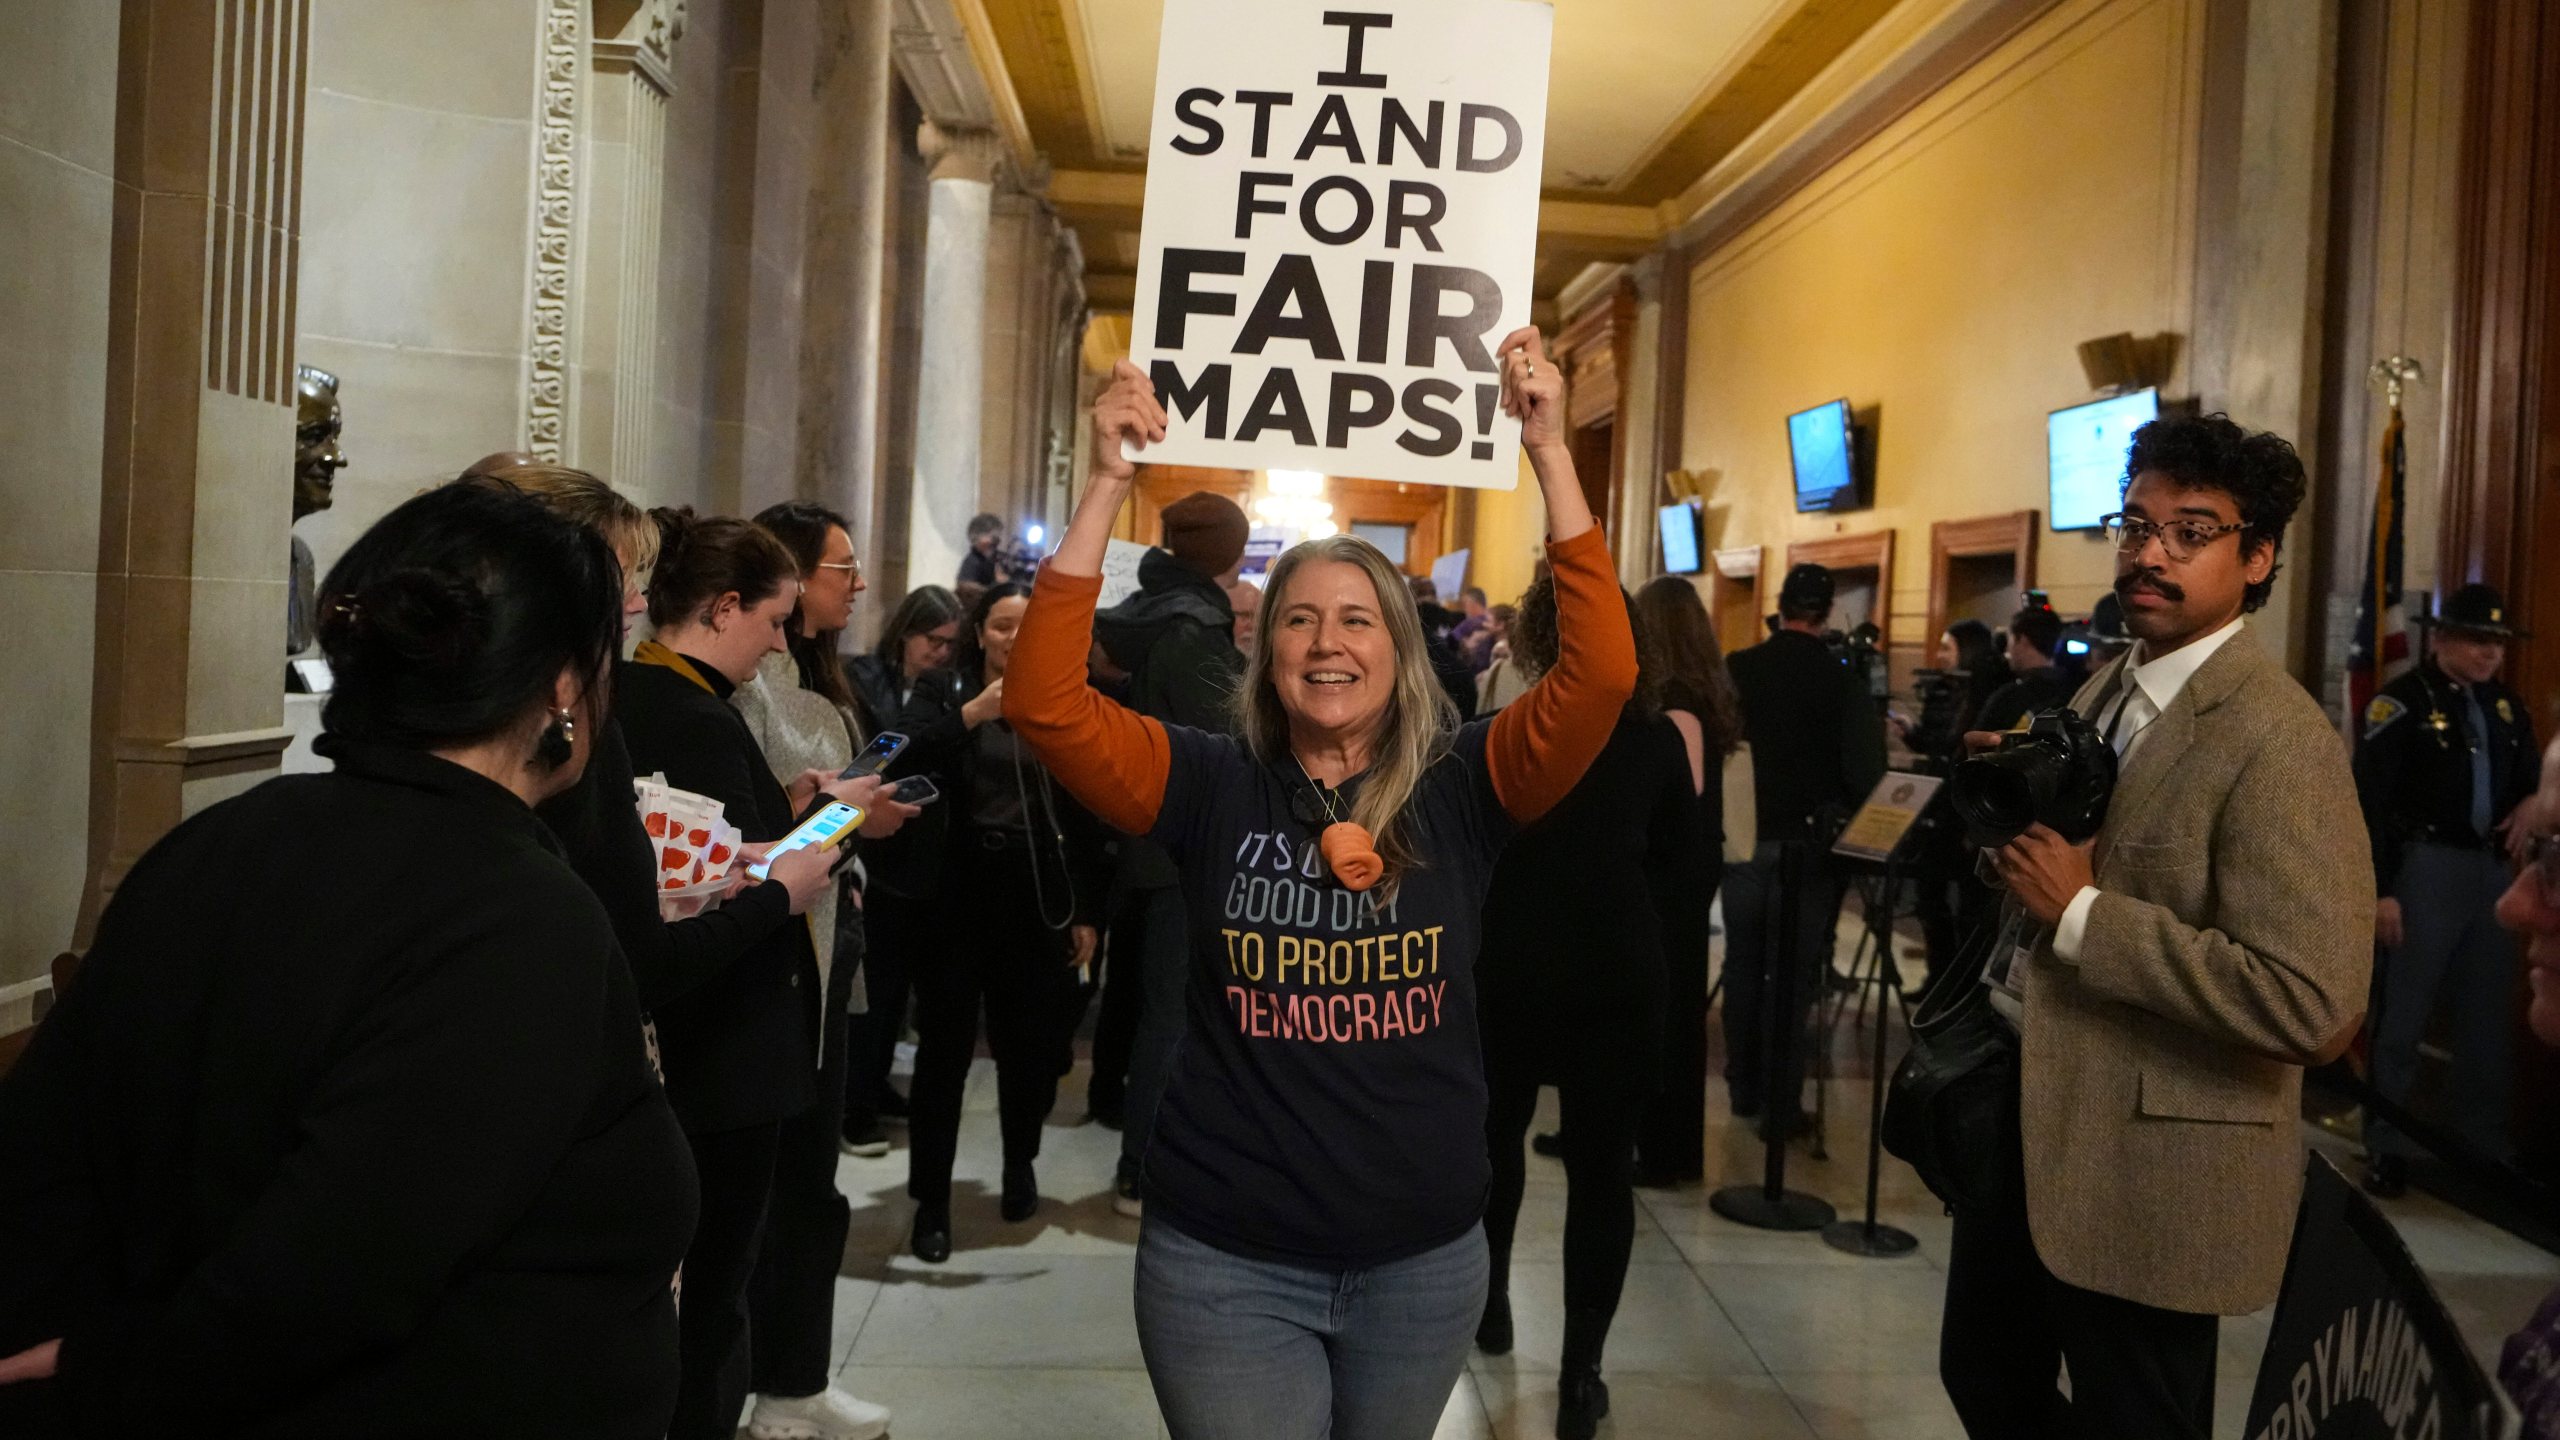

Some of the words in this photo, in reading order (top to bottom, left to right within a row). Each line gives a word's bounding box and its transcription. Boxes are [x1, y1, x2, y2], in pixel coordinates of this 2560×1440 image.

[1317, 11, 1393, 89] I
[1170, 87, 1523, 173] STAND
[1234, 170, 1447, 253] FOR
[1154, 247, 1504, 374] FAIR
[1150, 359, 1500, 461] MAPS!
[1224, 871, 1321, 928] GOOD
[1331, 882, 1400, 932] DAY
[1221, 928, 1265, 982] TO
[1277, 925, 1444, 986] PROTECT
[1226, 979, 1447, 1043] DEMOCRACY
